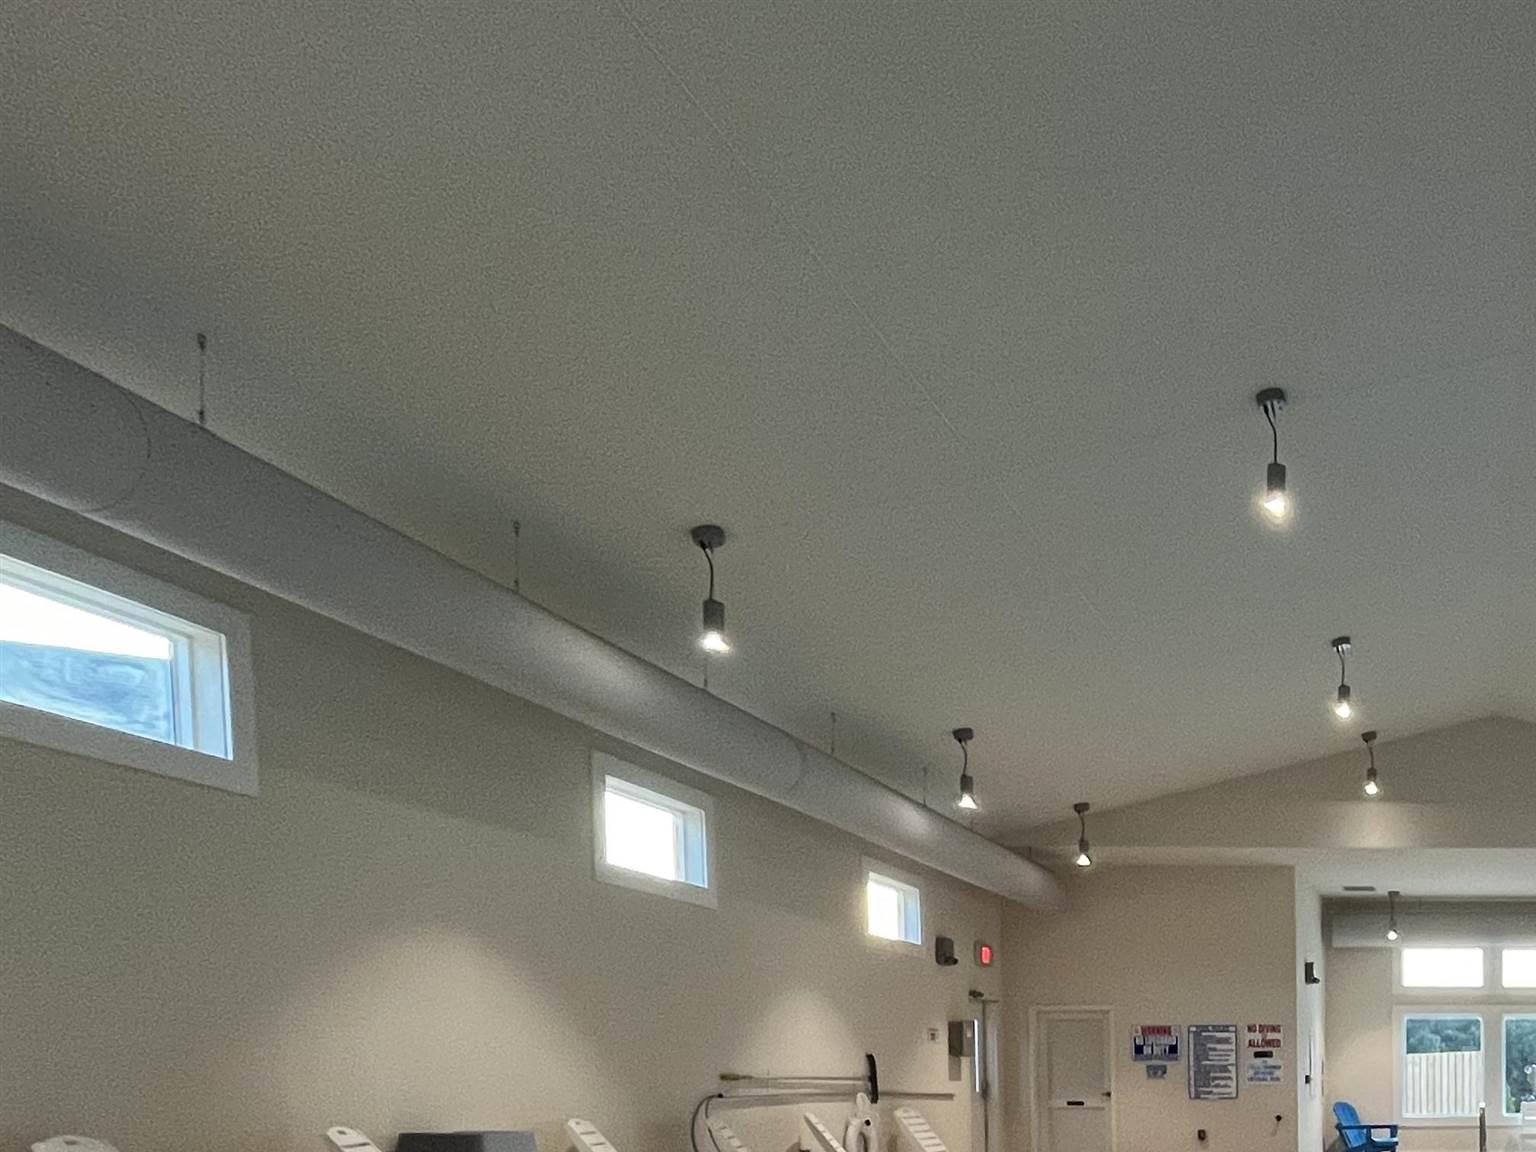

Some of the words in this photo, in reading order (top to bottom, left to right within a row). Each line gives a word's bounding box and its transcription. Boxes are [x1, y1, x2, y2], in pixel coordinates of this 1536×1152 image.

[1247, 1024, 1257, 1033] NO
[1259, 1024, 1281, 1034] DIVING
[1248, 1039, 1281, 1048] ALLOWED
